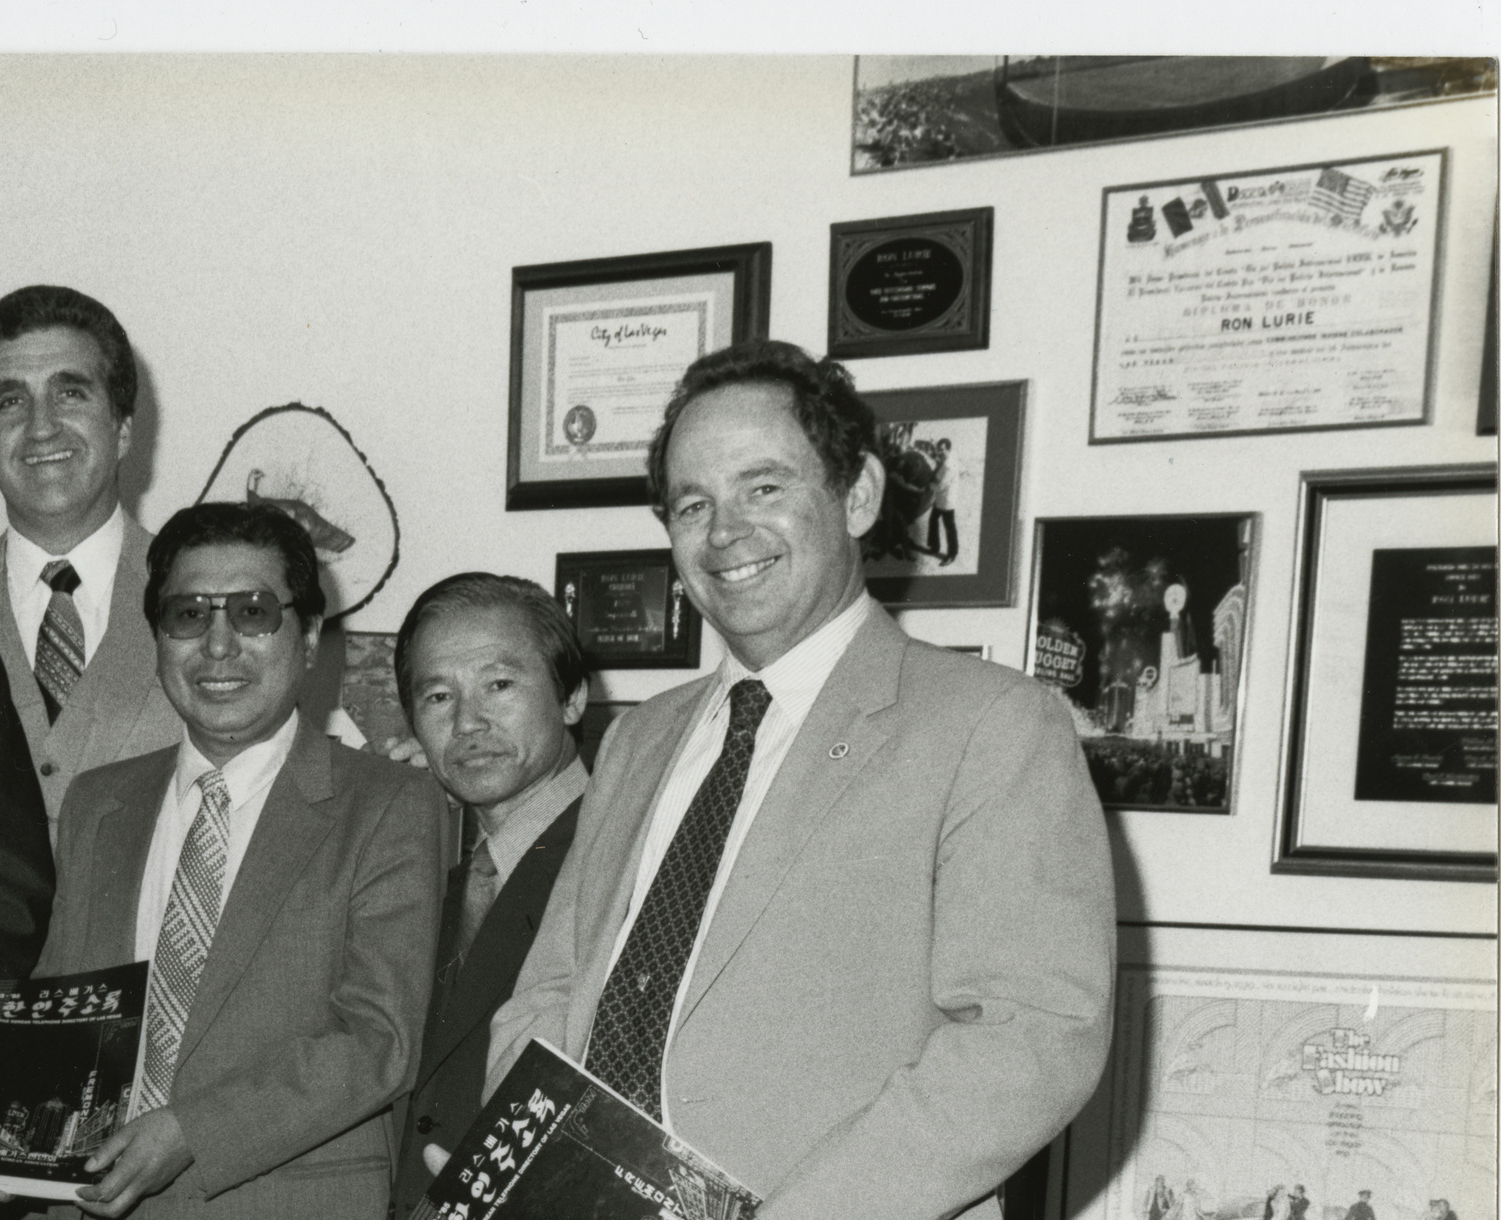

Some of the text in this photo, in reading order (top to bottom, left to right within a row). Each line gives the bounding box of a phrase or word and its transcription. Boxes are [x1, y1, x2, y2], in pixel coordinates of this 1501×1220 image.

[591, 323, 667, 347] City of Las Vegas
[1221, 311, 1315, 332] RON LURIE
[2, 989, 122, 1018] 한인주소록
[1331, 1027, 1371, 1048] The
[1302, 1043, 1400, 1073] Fashion
[78, 1070, 98, 1124] FREMONT
[1312, 1069, 1388, 1096] Show
[458, 1102, 524, 1184] 라스베가스
[493, 1173, 521, 1207] TELEPHONE
[517, 1142, 543, 1175] DIRECTORY
[540, 1133, 549, 1144] OF
[546, 1122, 558, 1135] LAS
[554, 1103, 572, 1123] VEGAS
[614, 1164, 685, 1217] FREMONT
